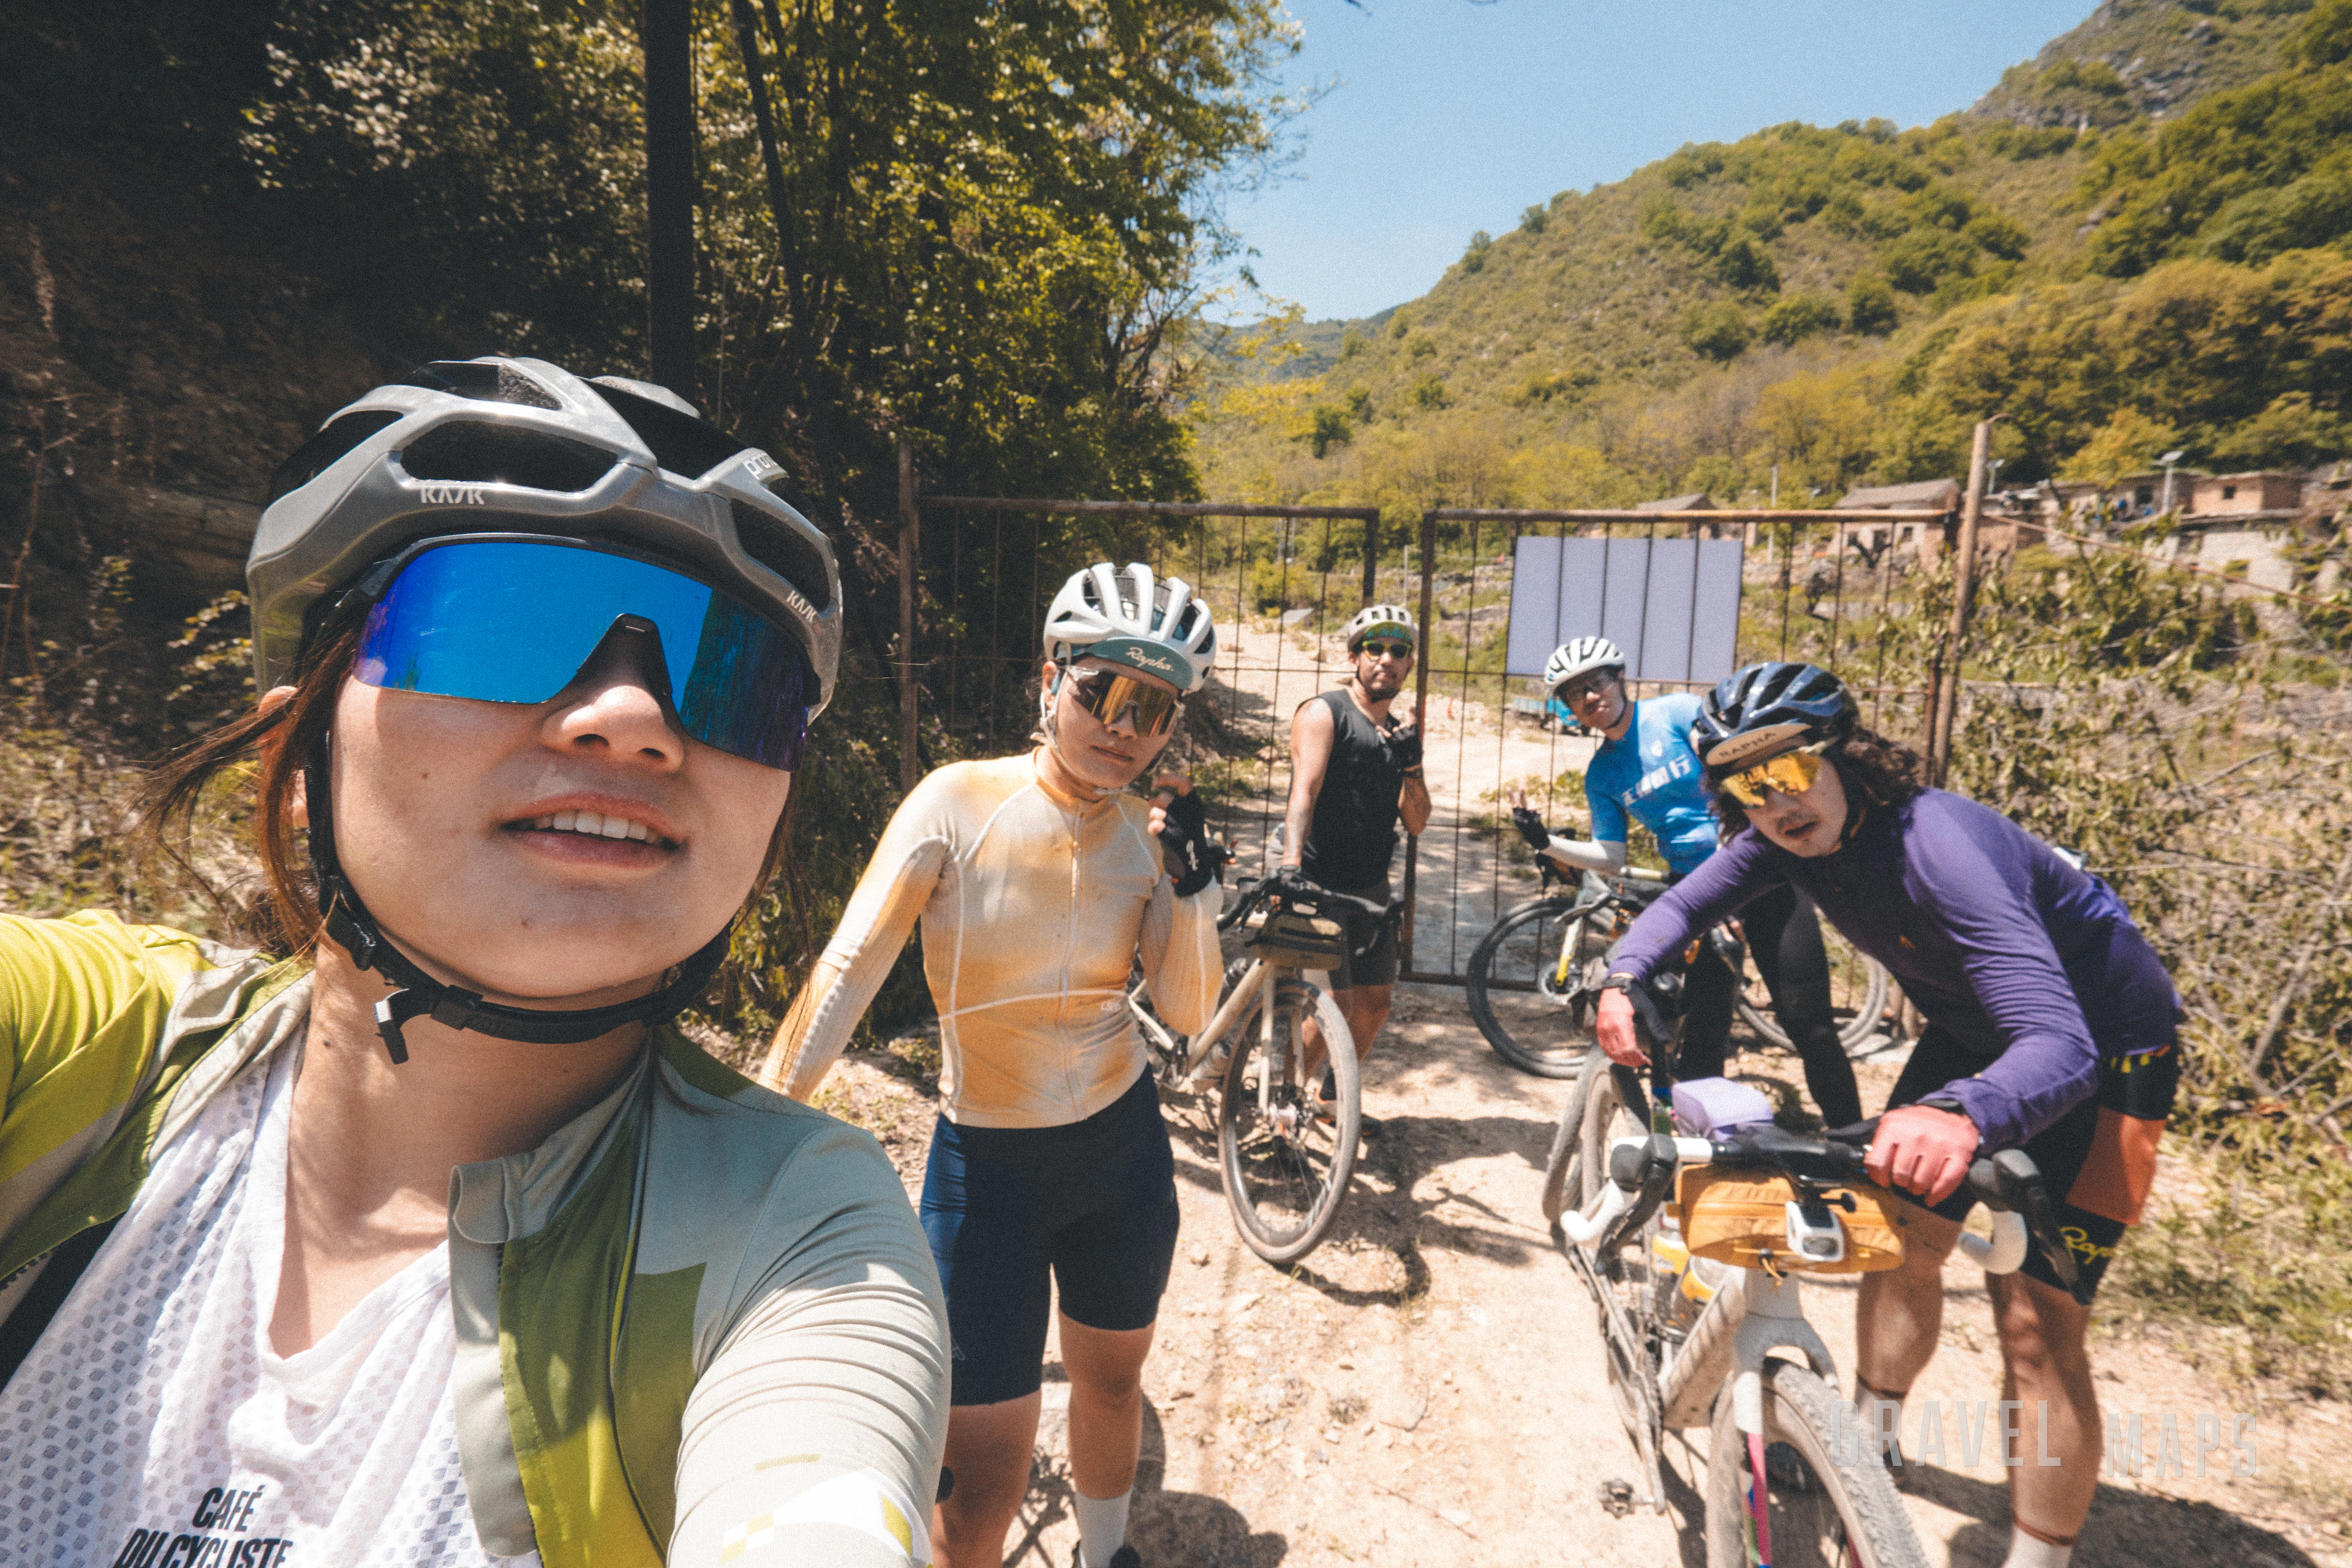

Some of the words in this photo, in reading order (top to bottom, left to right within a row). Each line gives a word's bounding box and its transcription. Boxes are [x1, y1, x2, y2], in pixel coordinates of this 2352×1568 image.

[421, 486, 485, 505] KASK
[786, 590, 818, 623] KASK
[1719, 733, 1776, 757] RAPHA
[192, 1484, 265, 1532] CAFÉ
[112, 1528, 170, 1568] DU
[158, 1533, 293, 1568] CYCLISTE
